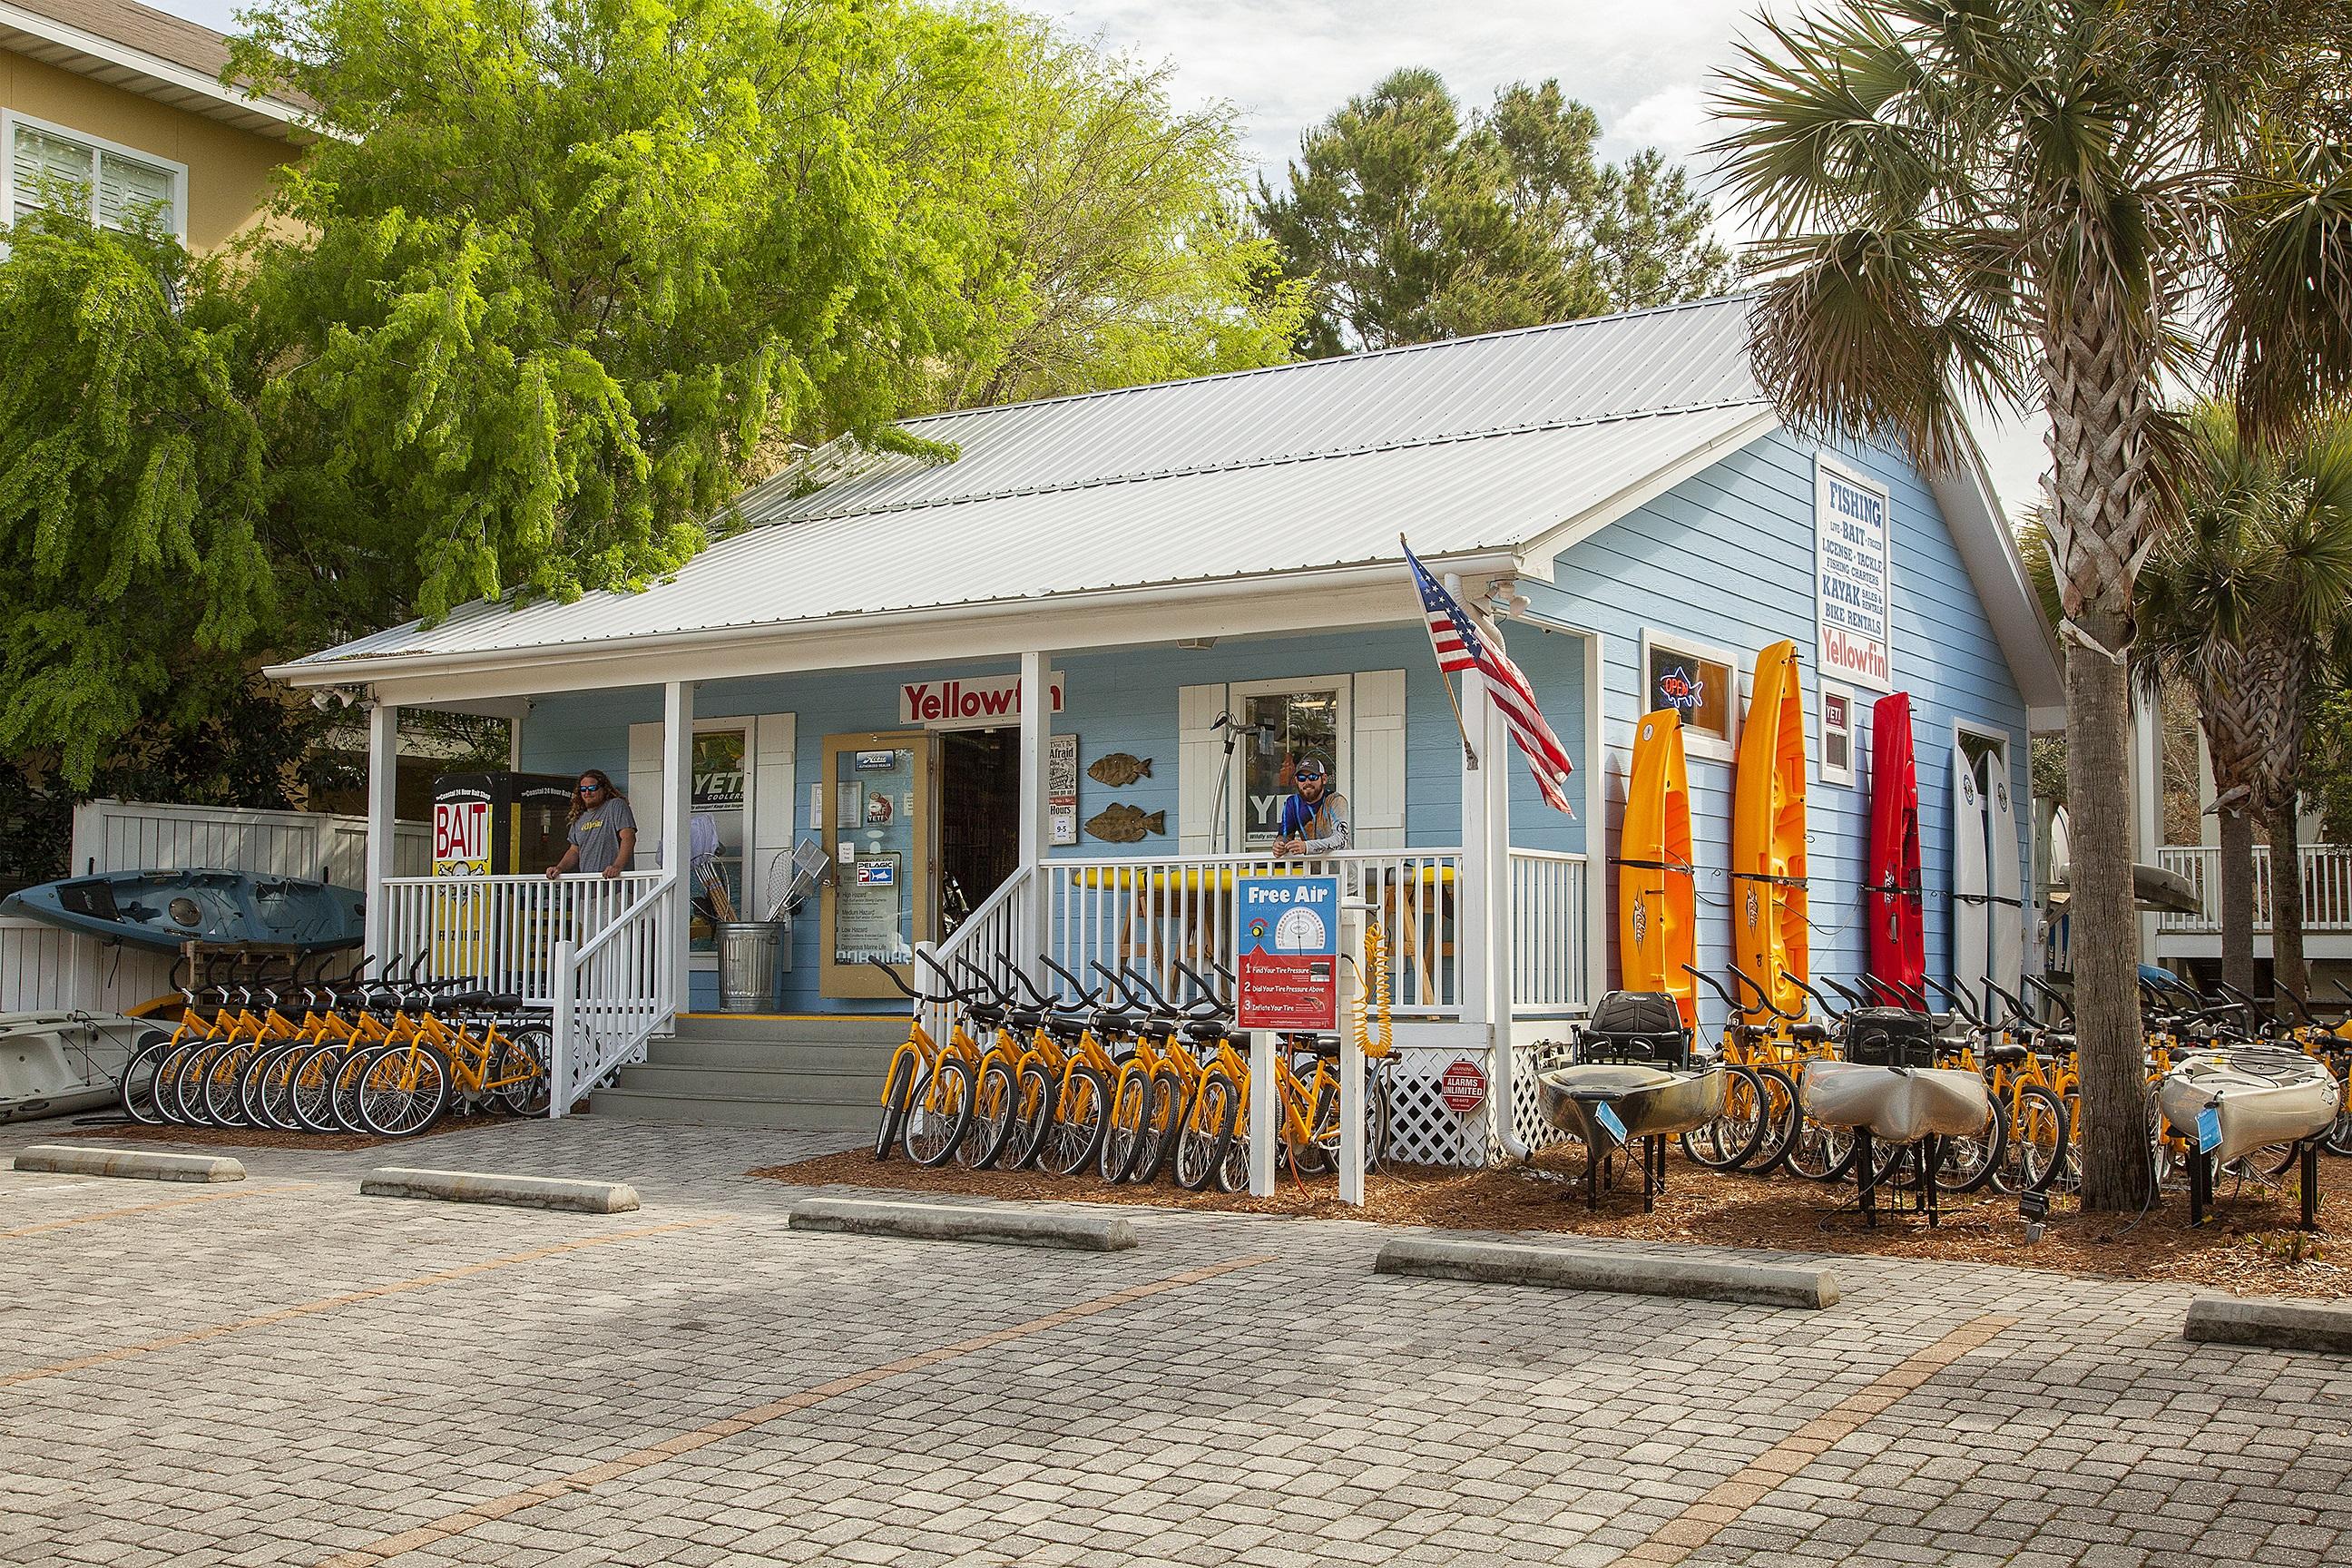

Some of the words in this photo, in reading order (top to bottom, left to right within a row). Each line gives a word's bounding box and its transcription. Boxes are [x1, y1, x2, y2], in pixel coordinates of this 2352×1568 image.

[1829, 480, 1881, 528] FISHING
[1842, 521, 1866, 546] BAIT
[1822, 537, 1853, 562] LICENSE
[1857, 552, 1883, 573] TACKLE
[1827, 557, 1849, 574] FISHING
[1851, 567, 1879, 586] CHARTERS
[1822, 574, 1860, 607] KAYAK
[1862, 589, 1877, 603] SALES
[1862, 600, 1884, 615] RENTALS
[1825, 603, 1845, 622] BIKE
[1847, 610, 1881, 635] RENTALS
[1822, 627, 1886, 680] Yellowfin
[1665, 678, 1688, 697] OPEN
[904, 677, 1061, 720] Yellowfn
[1826, 705, 1842, 721] YETI
[1050, 747, 1073, 759] Afraid
[544, 787, 551, 795] 24
[694, 771, 744, 795] YET
[1050, 805, 1071, 815] Hours
[436, 803, 486, 858] BAIT
[1248, 887, 1290, 904] Free
[1294, 885, 1328, 903] Air
[1747, 888, 1759, 927] Hobie
[1634, 898, 1646, 942] Hobie
[1245, 963, 1251, 974] 1
[1244, 981, 1250, 992] 2
[1244, 1000, 1251, 1011] 3
[1252, 1004, 1270, 1012] Inflate
[1443, 1086, 1483, 1096] UNLIMITED
[1446, 1077, 1478, 1087] ALARMS
